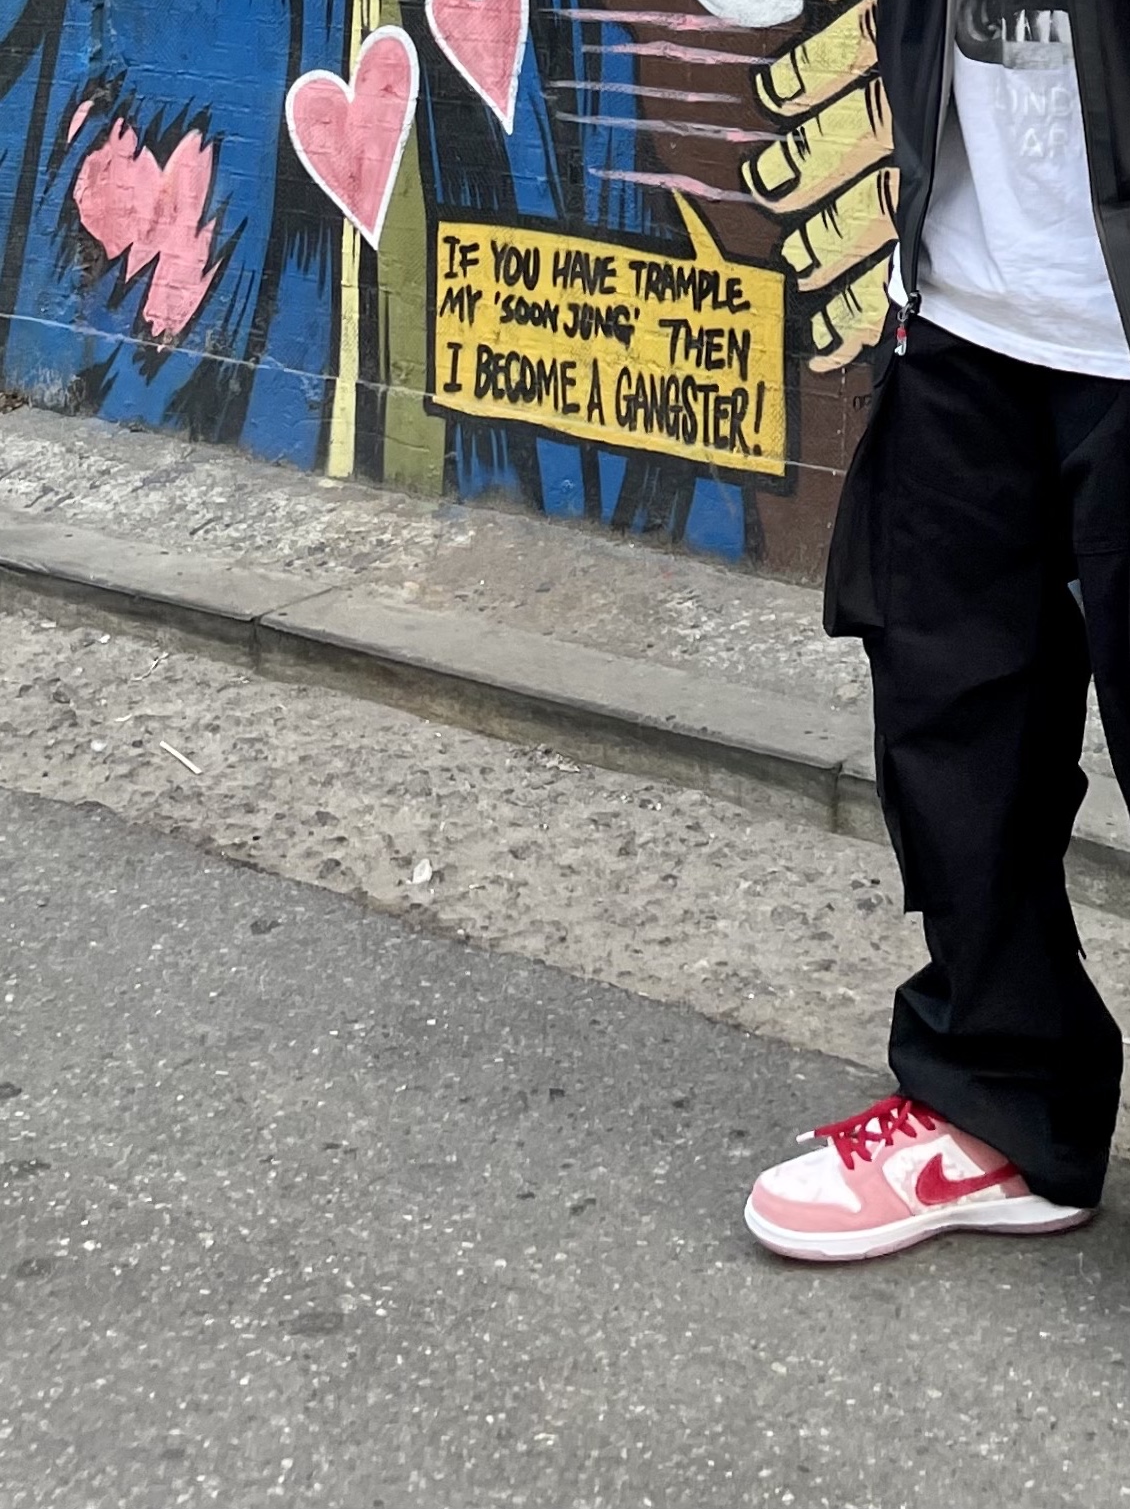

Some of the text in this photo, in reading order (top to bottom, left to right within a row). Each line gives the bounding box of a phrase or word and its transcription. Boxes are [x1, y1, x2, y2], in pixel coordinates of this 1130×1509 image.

[443, 236, 751, 314] IF YOU HAVE TRAMPLE
[440, 284, 483, 326] MY
[659, 319, 751, 381] THEN
[444, 341, 766, 457] I BECOME A GANGSTER!
